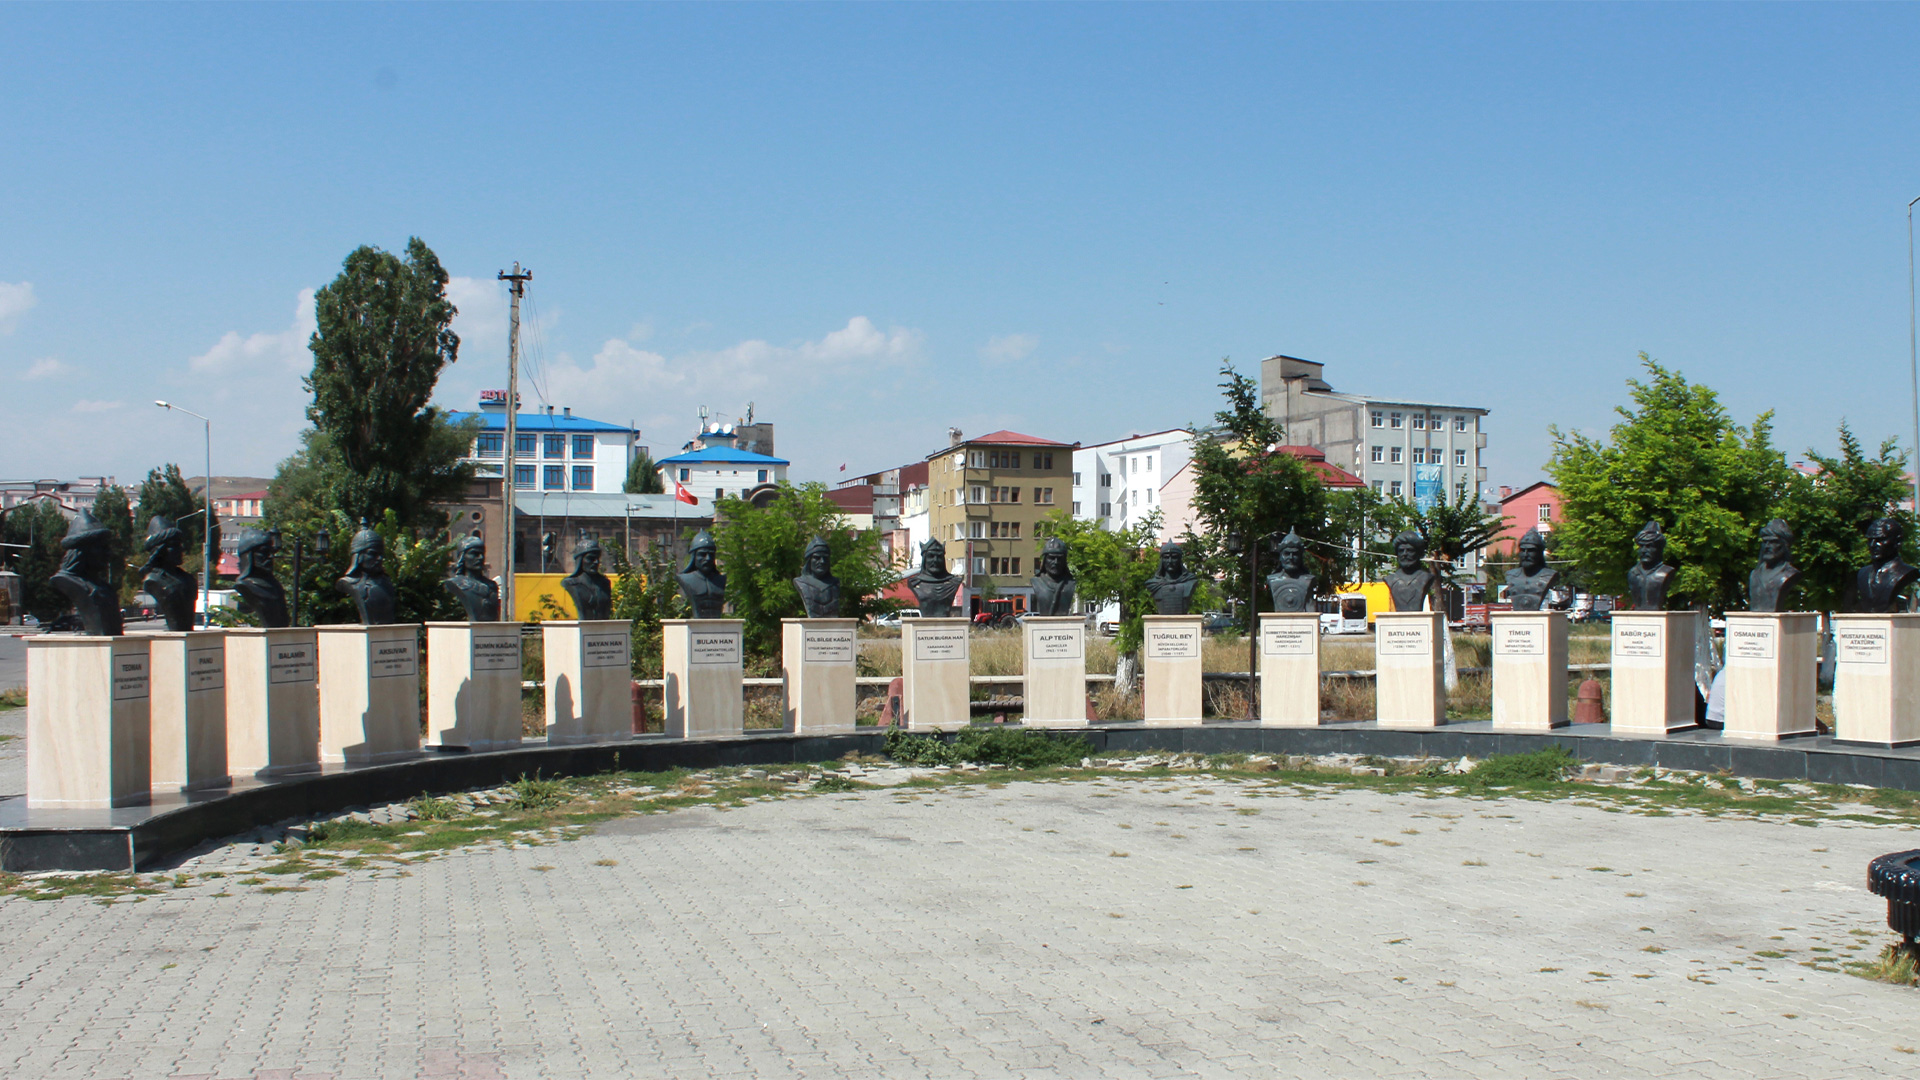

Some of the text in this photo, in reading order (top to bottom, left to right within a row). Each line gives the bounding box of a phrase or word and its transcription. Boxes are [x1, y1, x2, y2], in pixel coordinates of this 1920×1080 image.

[480, 389, 521, 401] HOT
[378, 647, 407, 656] AKSUVAR
[122, 663, 142, 672] TEOMAN
